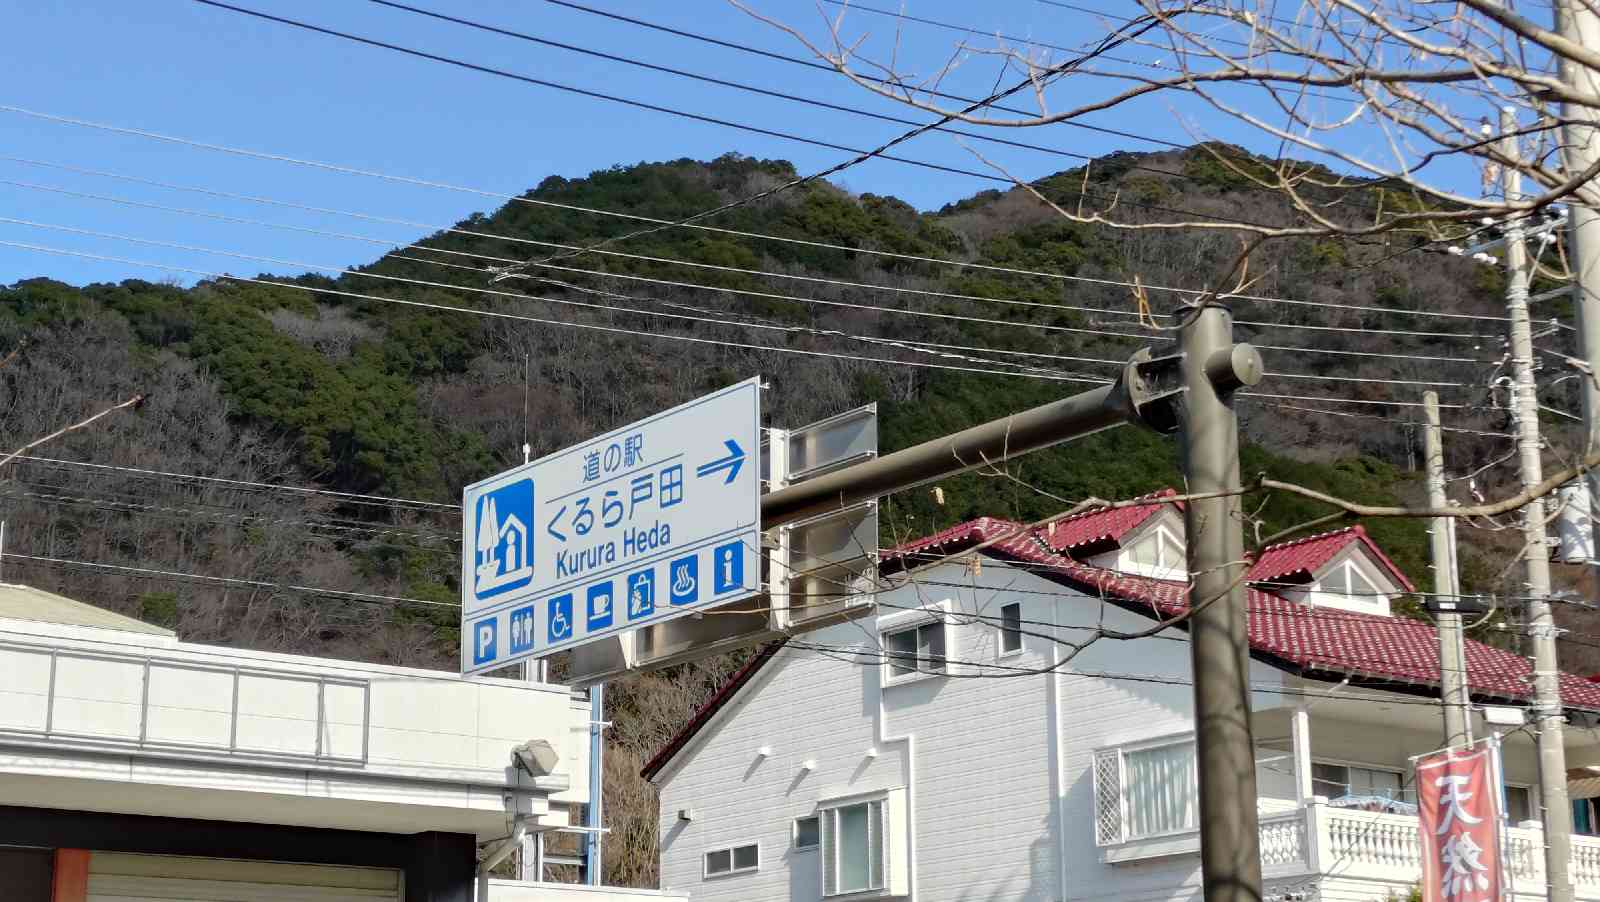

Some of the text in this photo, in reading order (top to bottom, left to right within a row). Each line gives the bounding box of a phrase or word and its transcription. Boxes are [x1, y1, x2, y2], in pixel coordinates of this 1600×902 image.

[582, 432, 644, 484] 道の駅
[547, 463, 684, 543] くるら戸田
[556, 519, 671, 580] Kurura Heda
[479, 625, 493, 658] P
[1435, 775, 1489, 898] 天然
